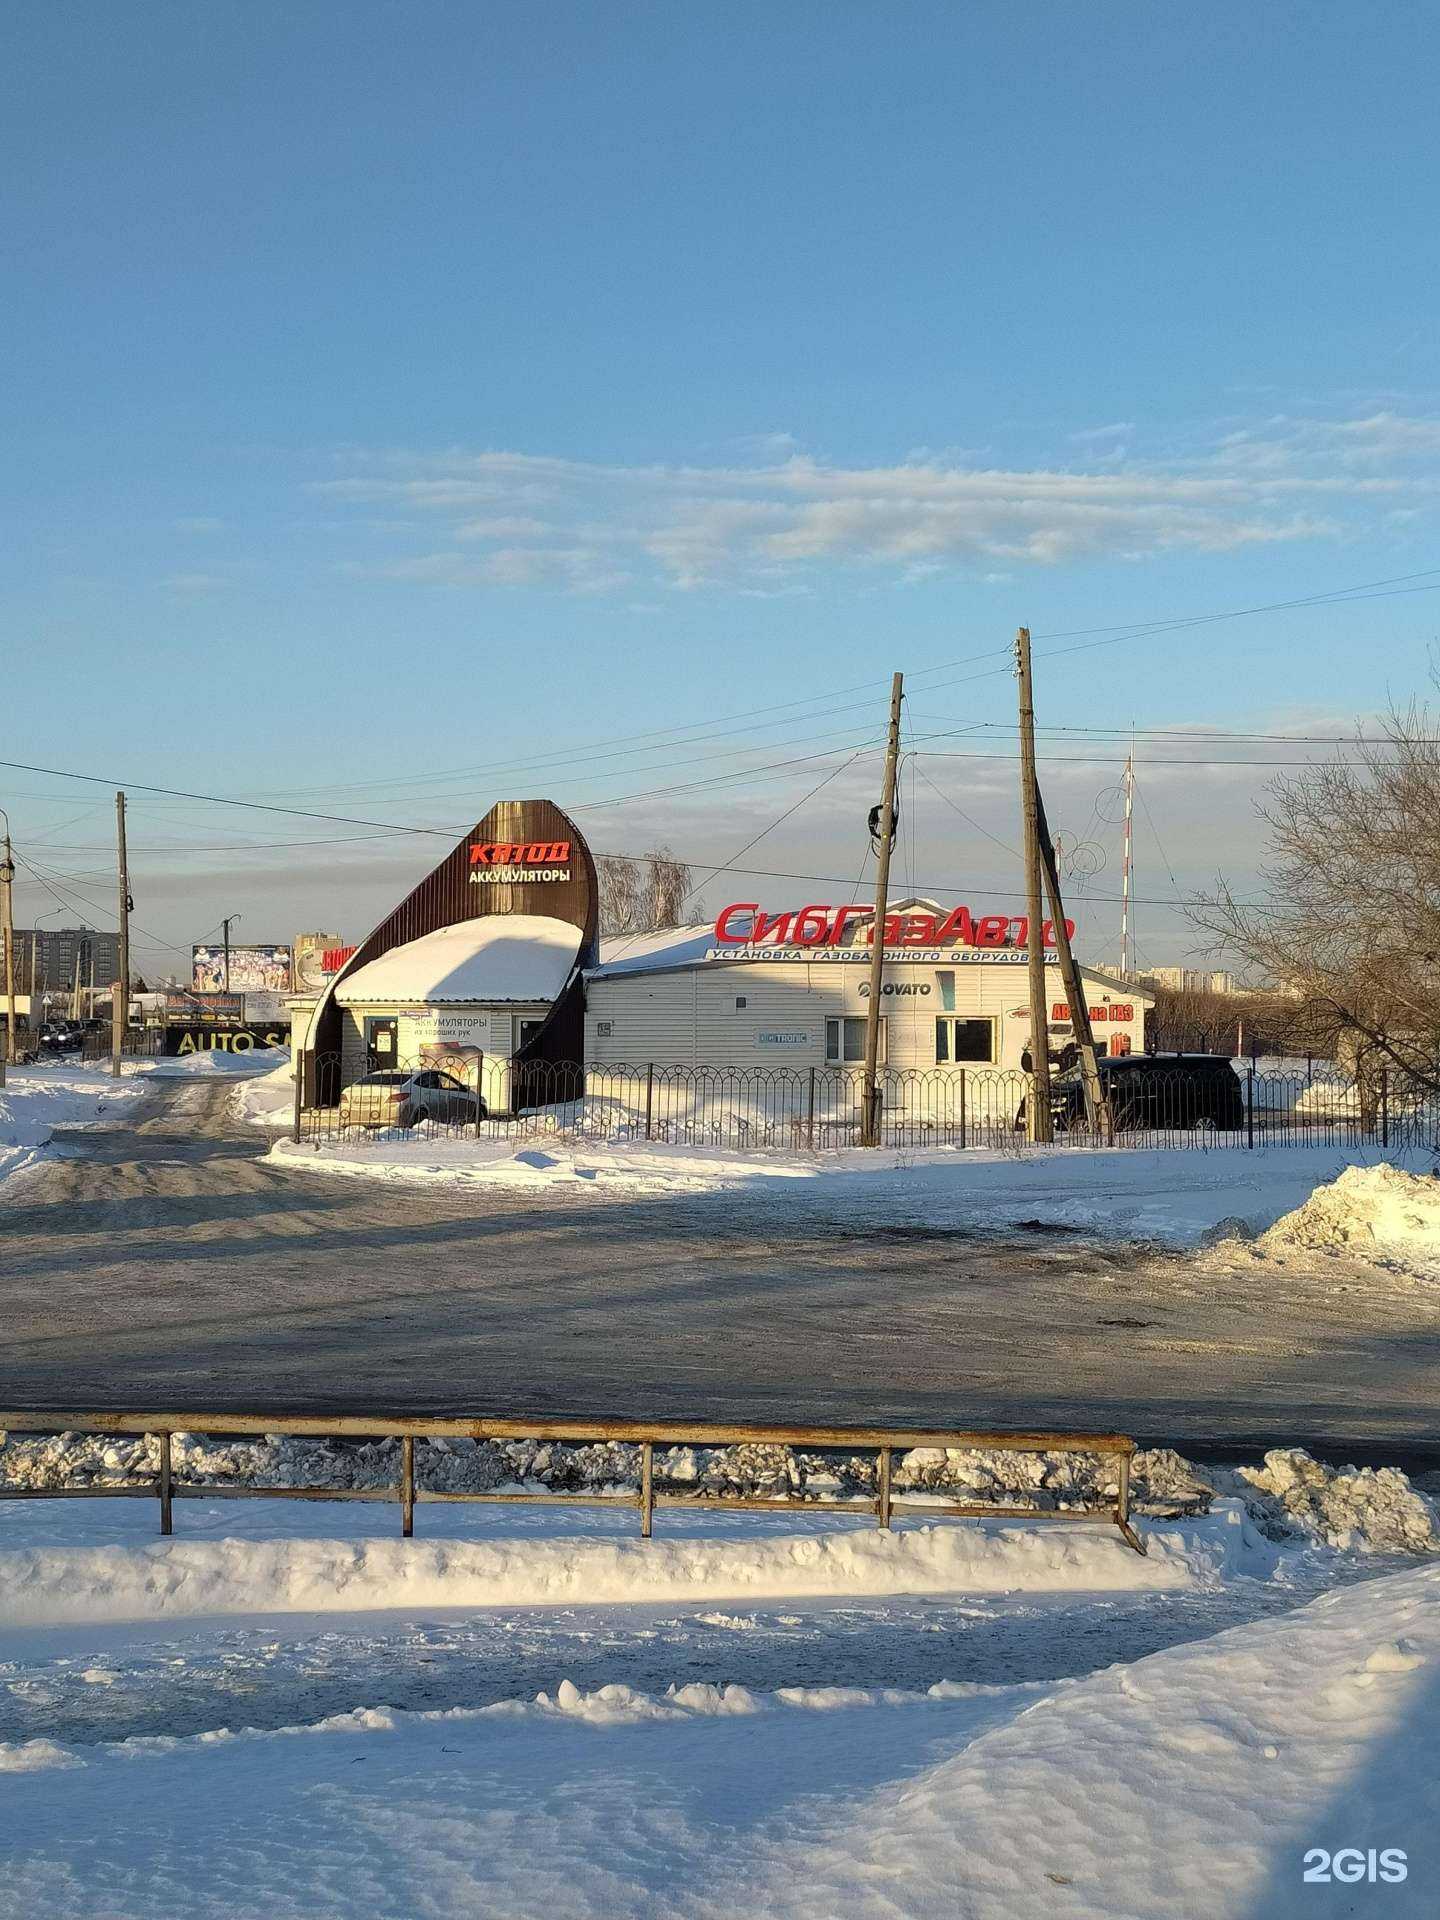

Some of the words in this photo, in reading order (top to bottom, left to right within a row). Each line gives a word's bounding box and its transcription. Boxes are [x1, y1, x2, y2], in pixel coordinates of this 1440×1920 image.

[470, 842, 569, 864] КАТОД
[469, 870, 570, 883] АККУМУЛЯТОРЫ
[713, 950, 801, 960] УСТАНОВКА
[812, 951, 940, 961] ГАЗОБАОННОГО
[880, 983, 931, 996] OVATO
[1109, 1004, 1134, 1021] ГАЗ
[178, 1032, 254, 1055] AUTO
